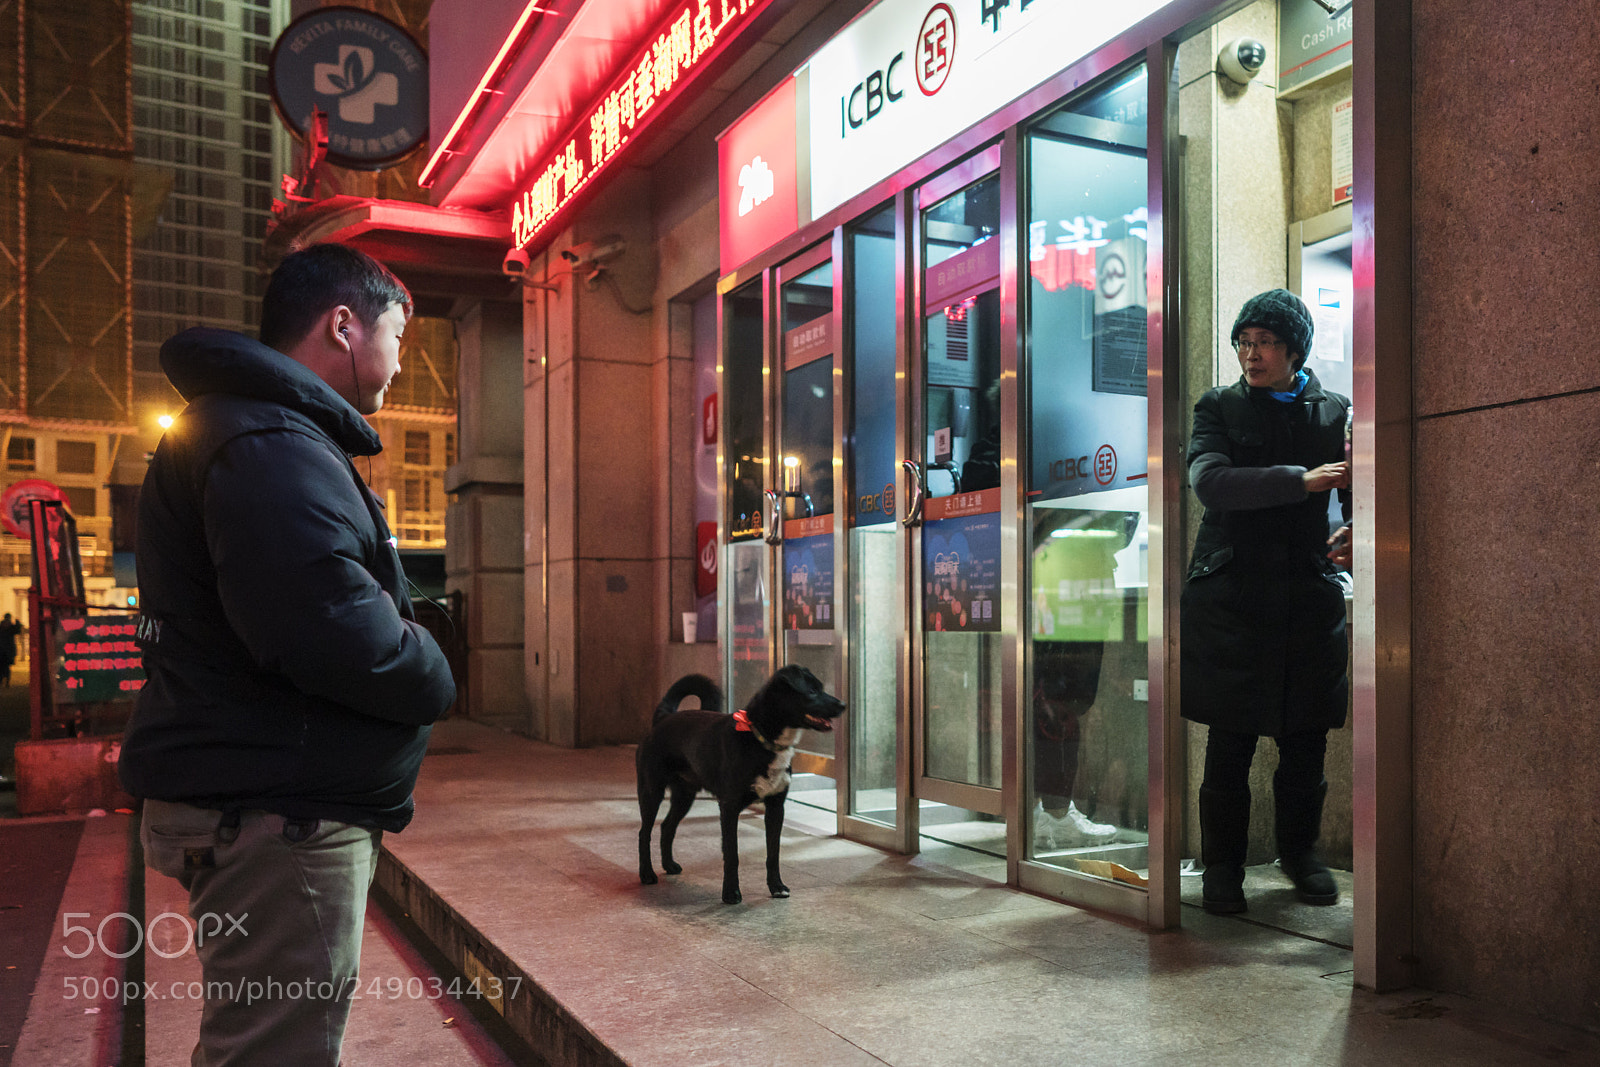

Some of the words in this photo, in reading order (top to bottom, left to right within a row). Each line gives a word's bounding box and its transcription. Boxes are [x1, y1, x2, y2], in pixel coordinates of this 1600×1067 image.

[1301, 25, 1333, 50] Cash
[841, 52, 903, 139] ICBC
[1049, 456, 1088, 485] ICBC
